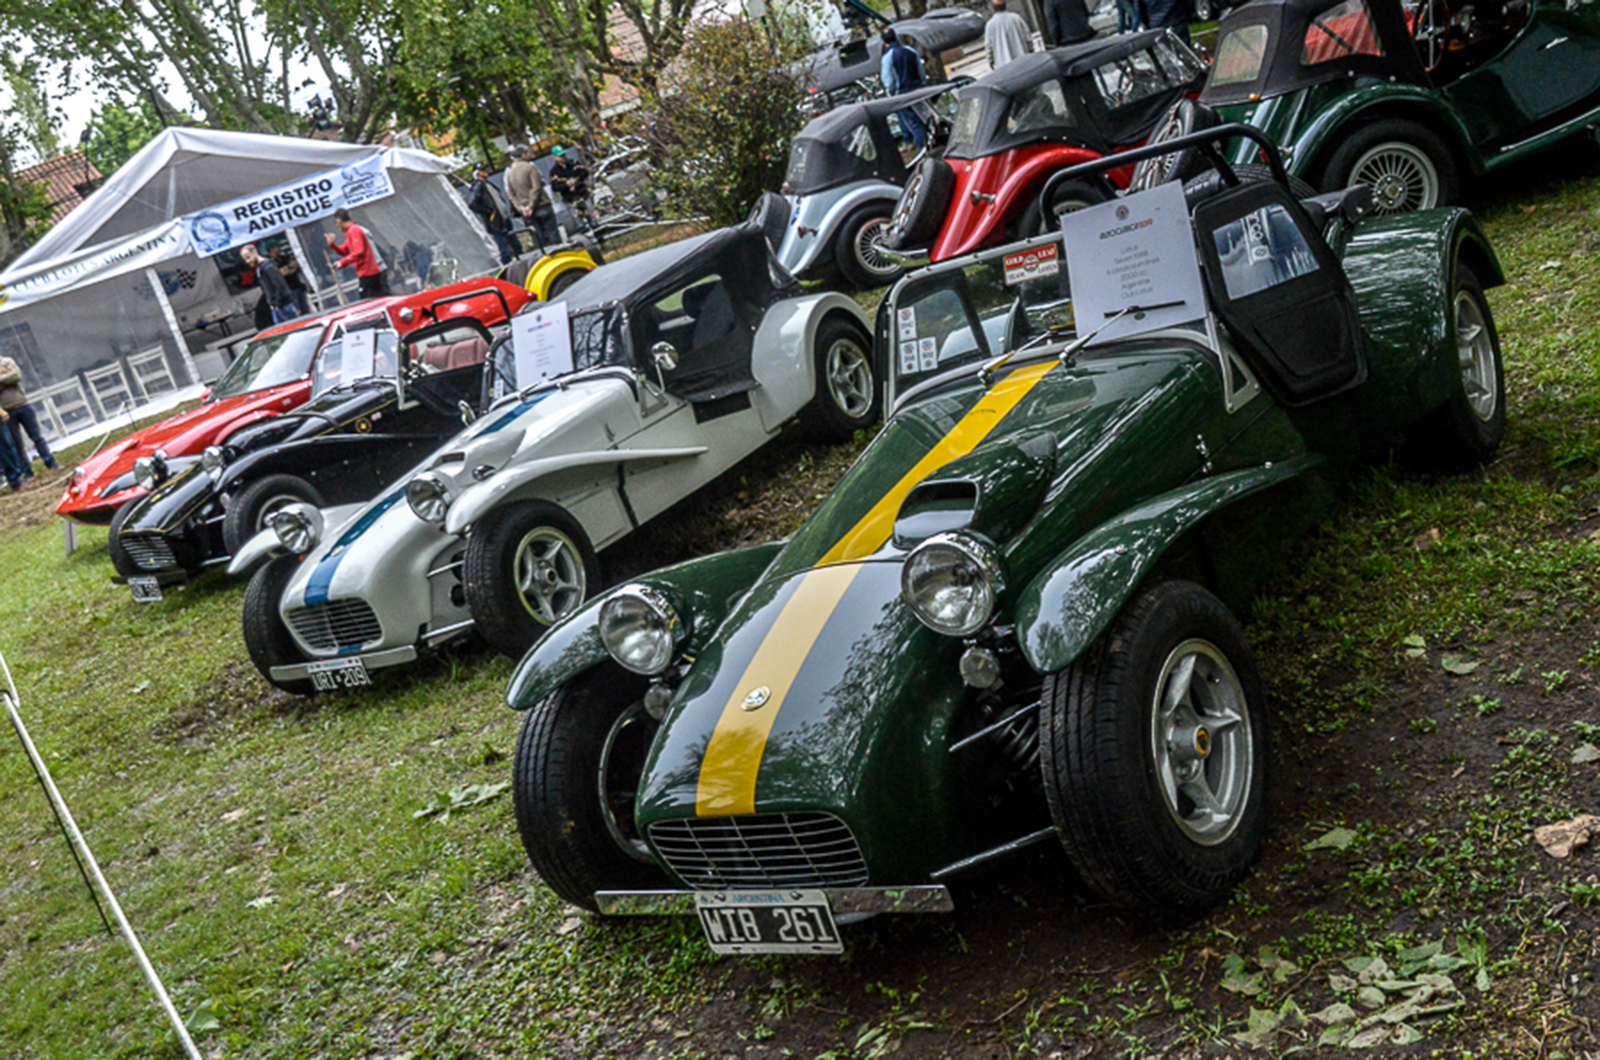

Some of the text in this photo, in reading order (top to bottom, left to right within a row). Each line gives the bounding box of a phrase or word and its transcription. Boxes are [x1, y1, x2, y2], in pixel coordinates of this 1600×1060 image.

[233, 179, 333, 221] REGISTRO
[249, 195, 333, 234] ANTIQUE
[731, 894, 786, 904] ARGENTINA
[703, 908, 834, 942] WIB 261
